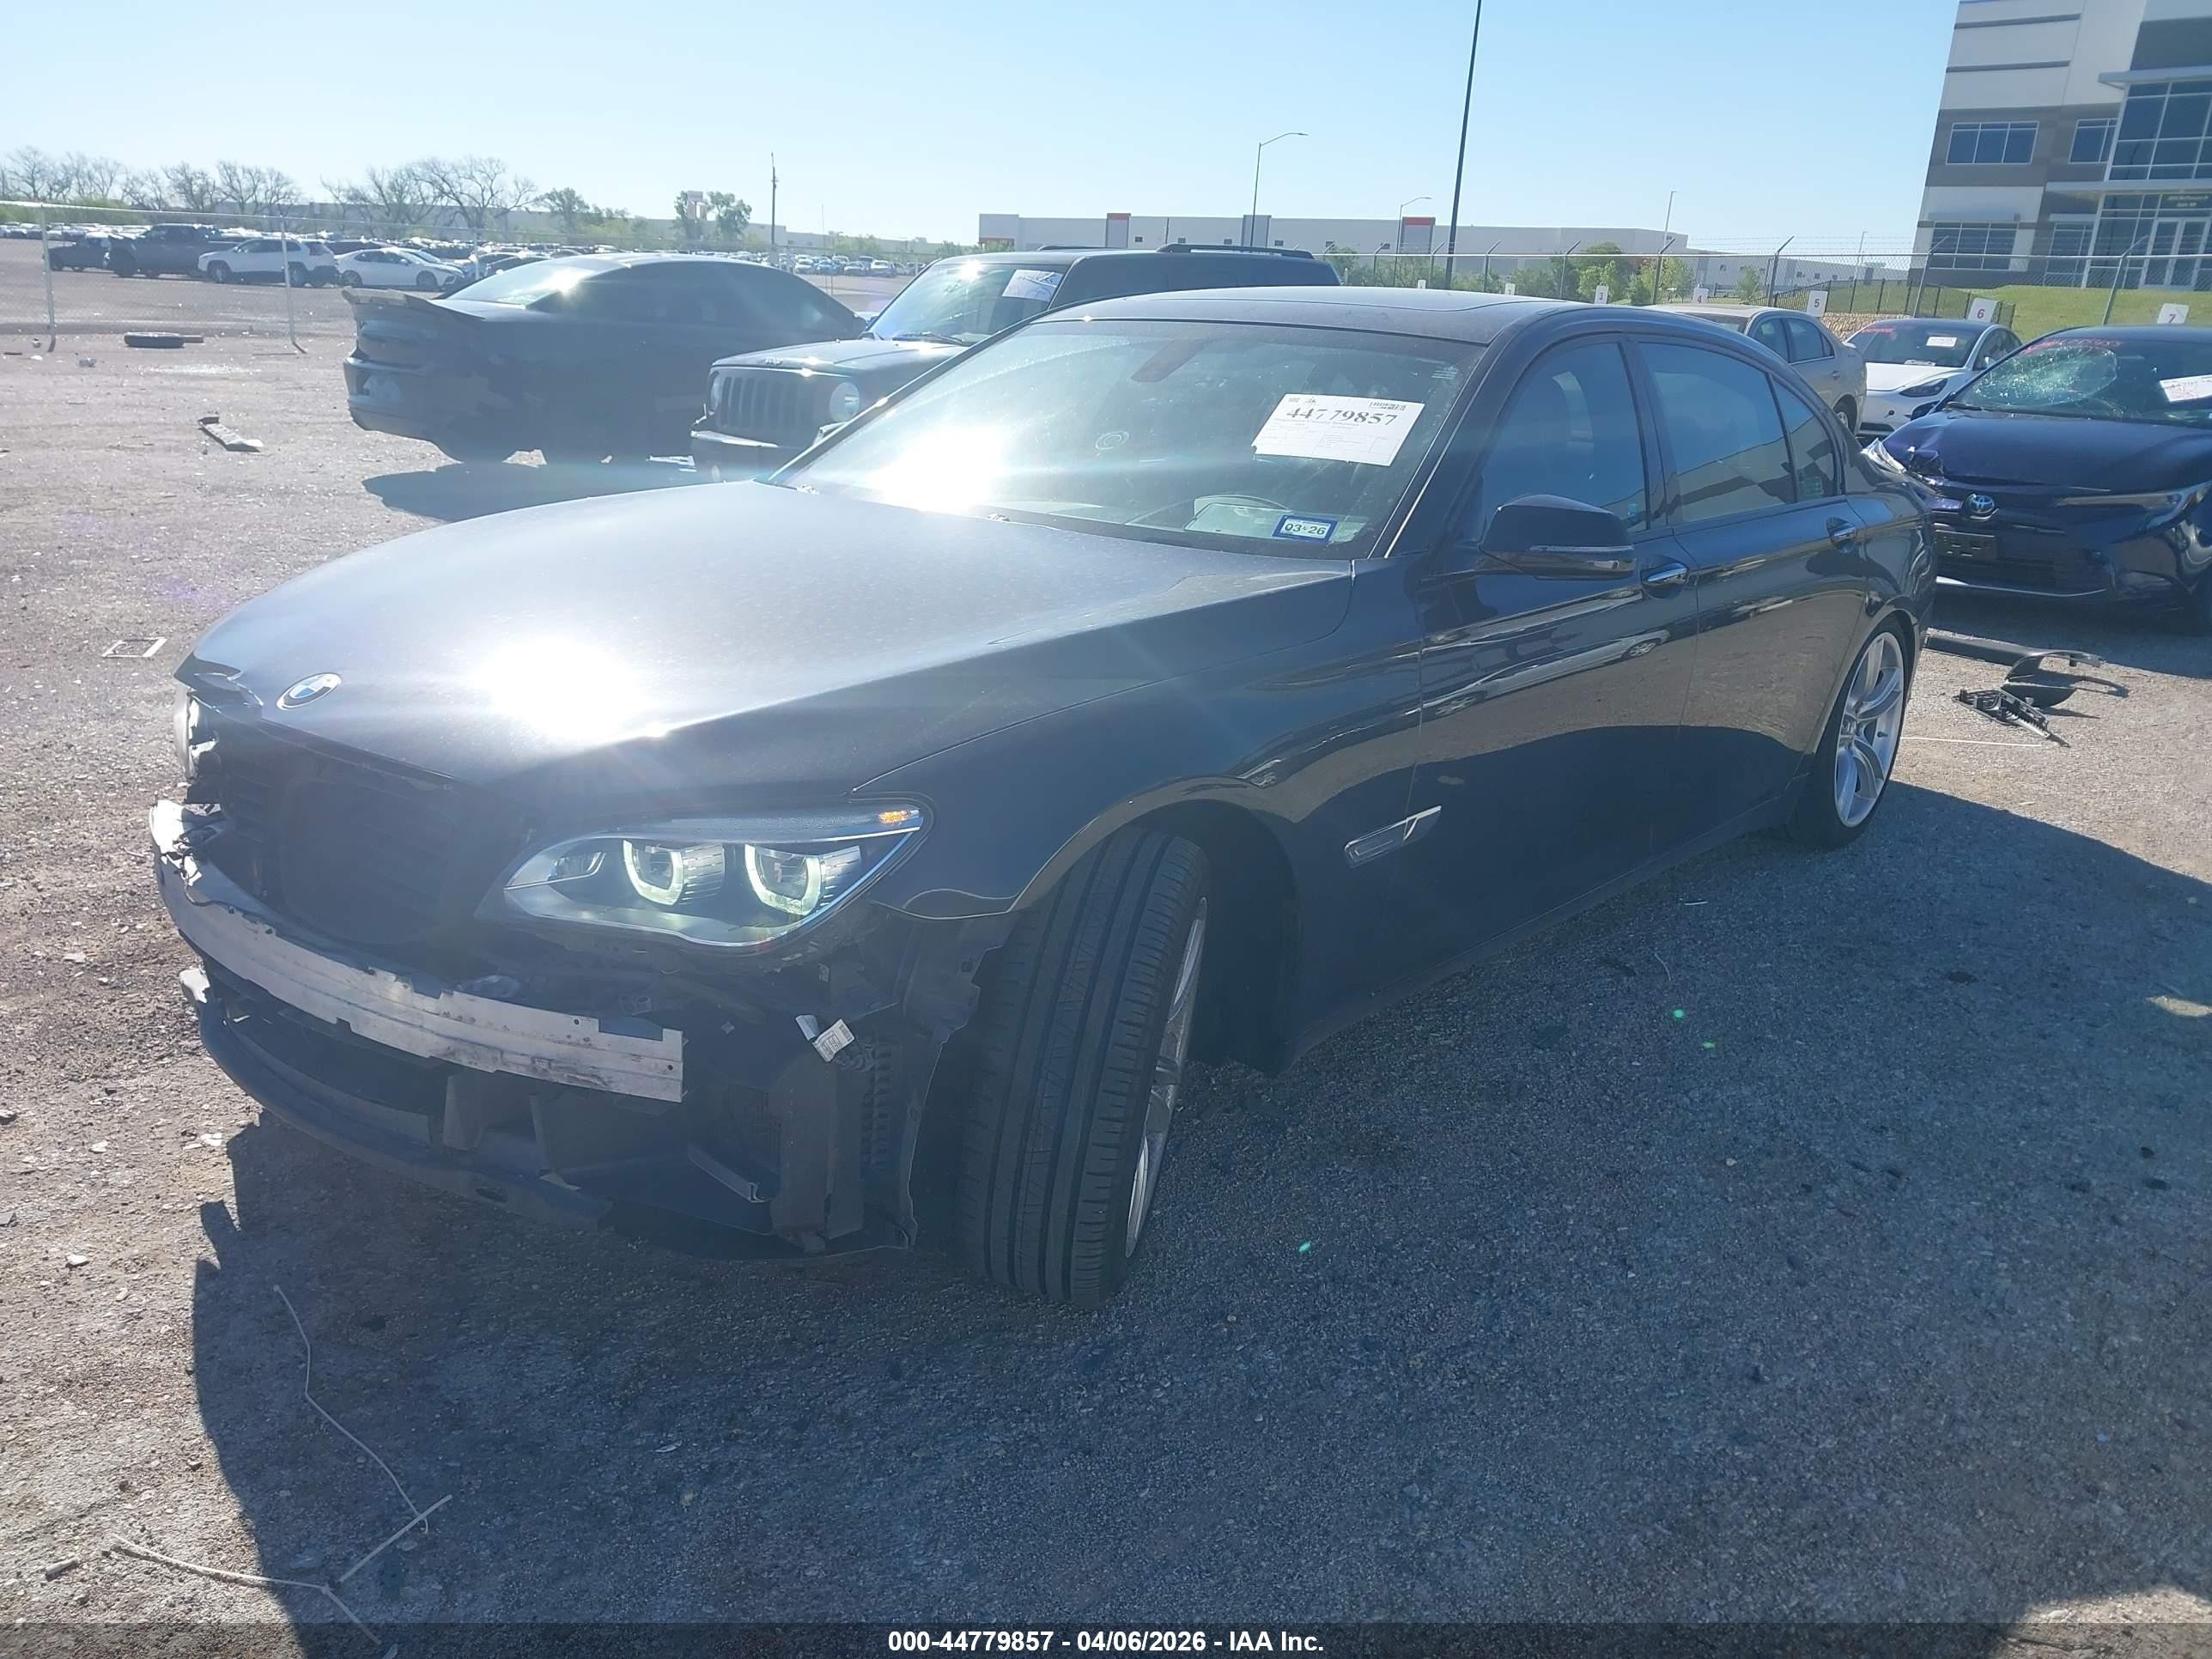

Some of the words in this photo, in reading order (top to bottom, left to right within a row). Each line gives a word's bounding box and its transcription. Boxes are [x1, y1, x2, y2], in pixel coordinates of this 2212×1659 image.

[1814, 298, 1820, 308] 5
[1977, 308, 1985, 319] 6
[2168, 313, 2177, 324] 7
[1286, 407, 1398, 426] 44779857
